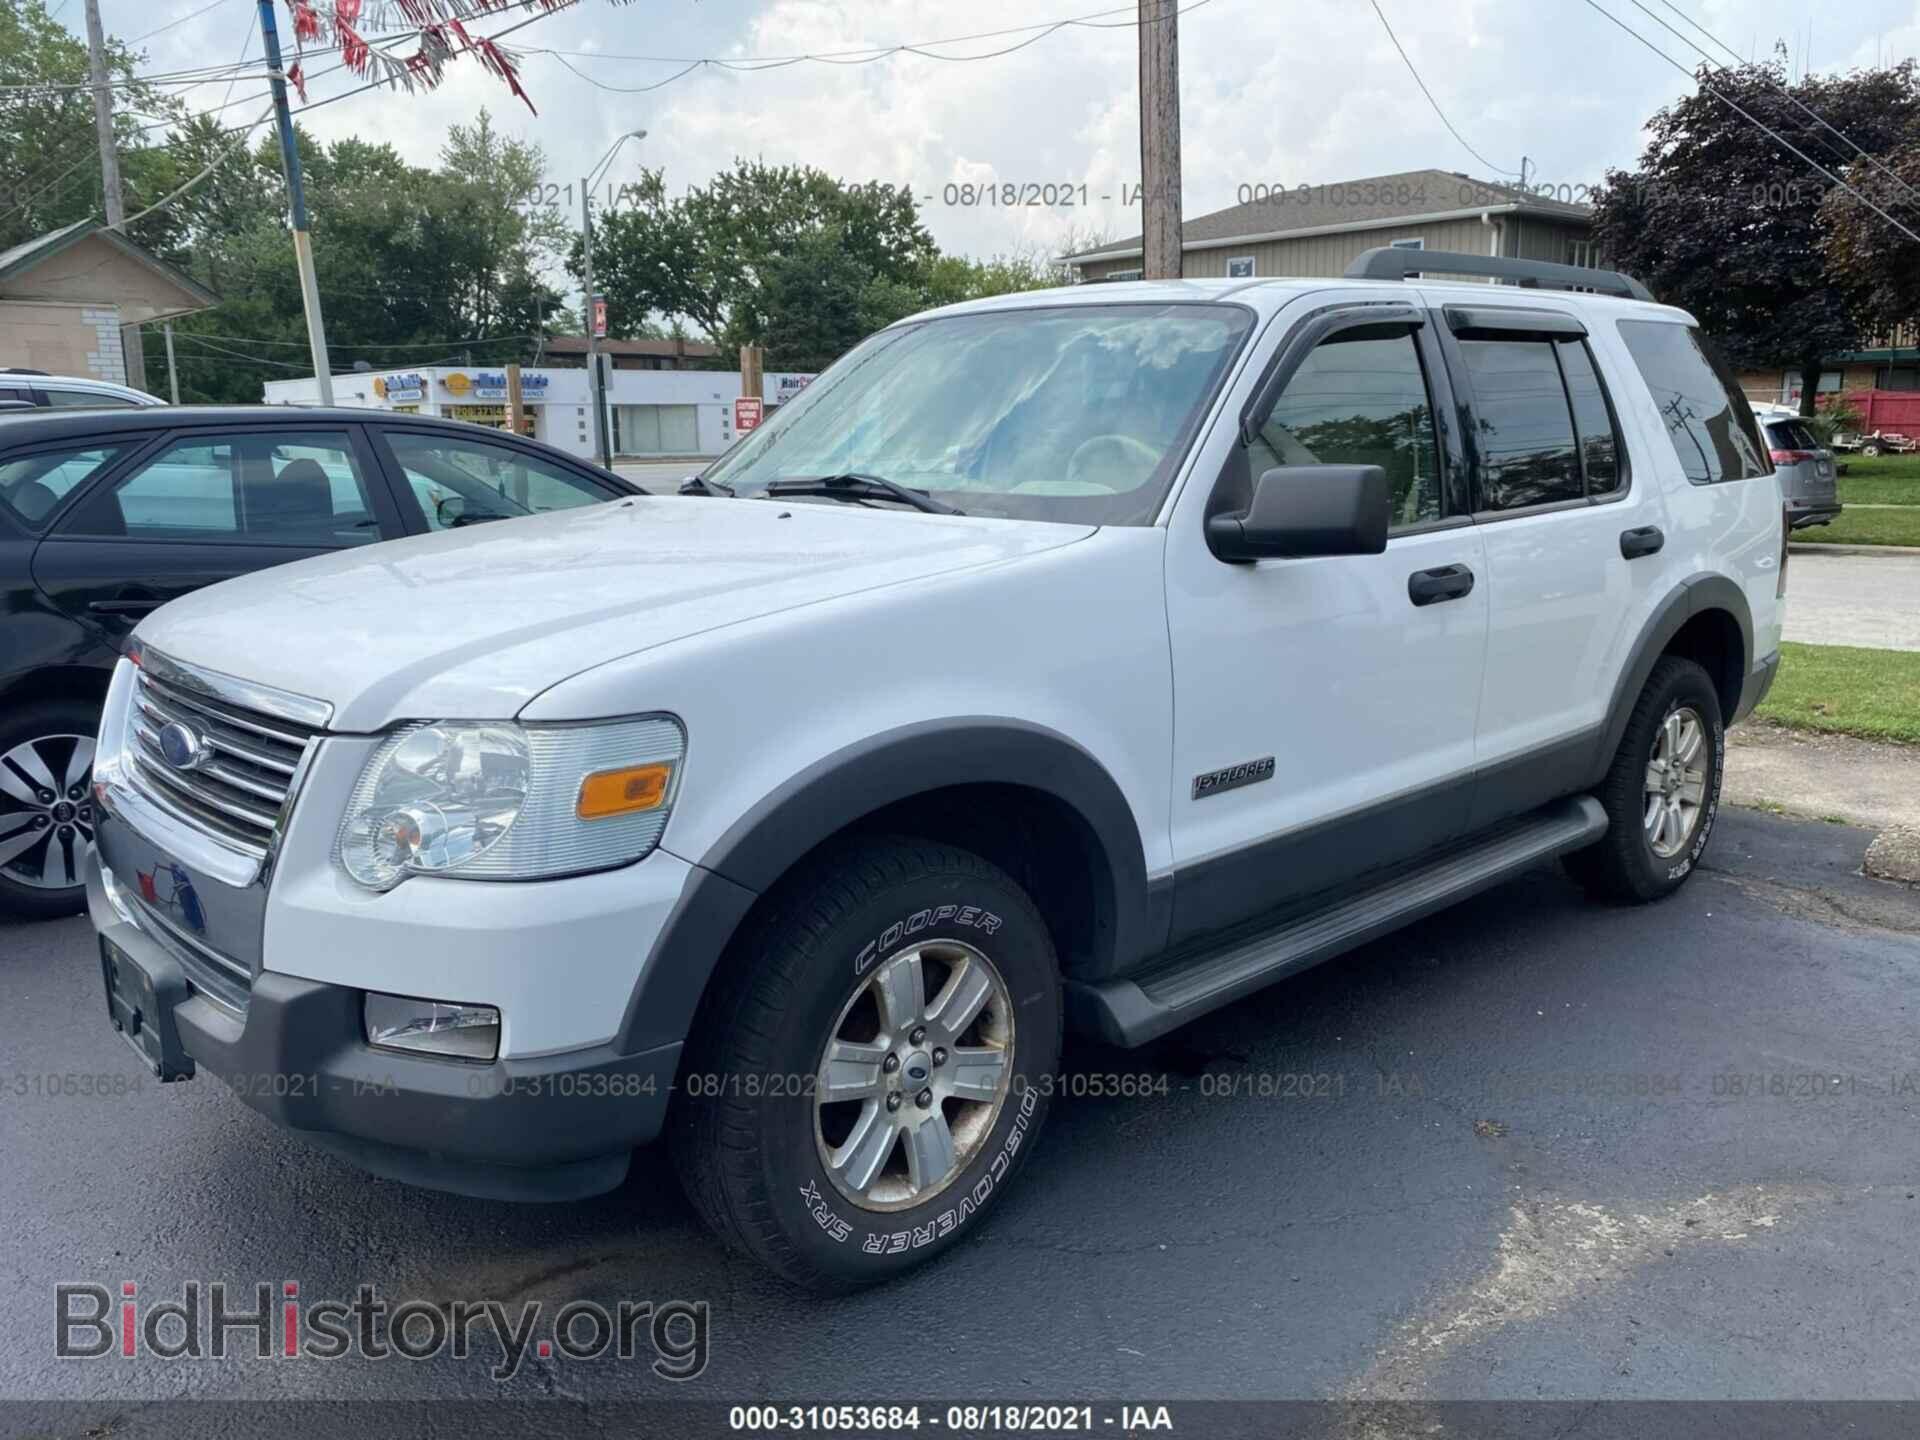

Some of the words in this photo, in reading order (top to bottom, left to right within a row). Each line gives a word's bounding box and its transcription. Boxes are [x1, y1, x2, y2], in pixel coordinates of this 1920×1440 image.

[1195, 758, 1274, 791] EXPLORER
[855, 905, 1002, 975] COOPER
[863, 1086, 1038, 1254] DISCOVERER
[800, 1179, 853, 1242] SRX
